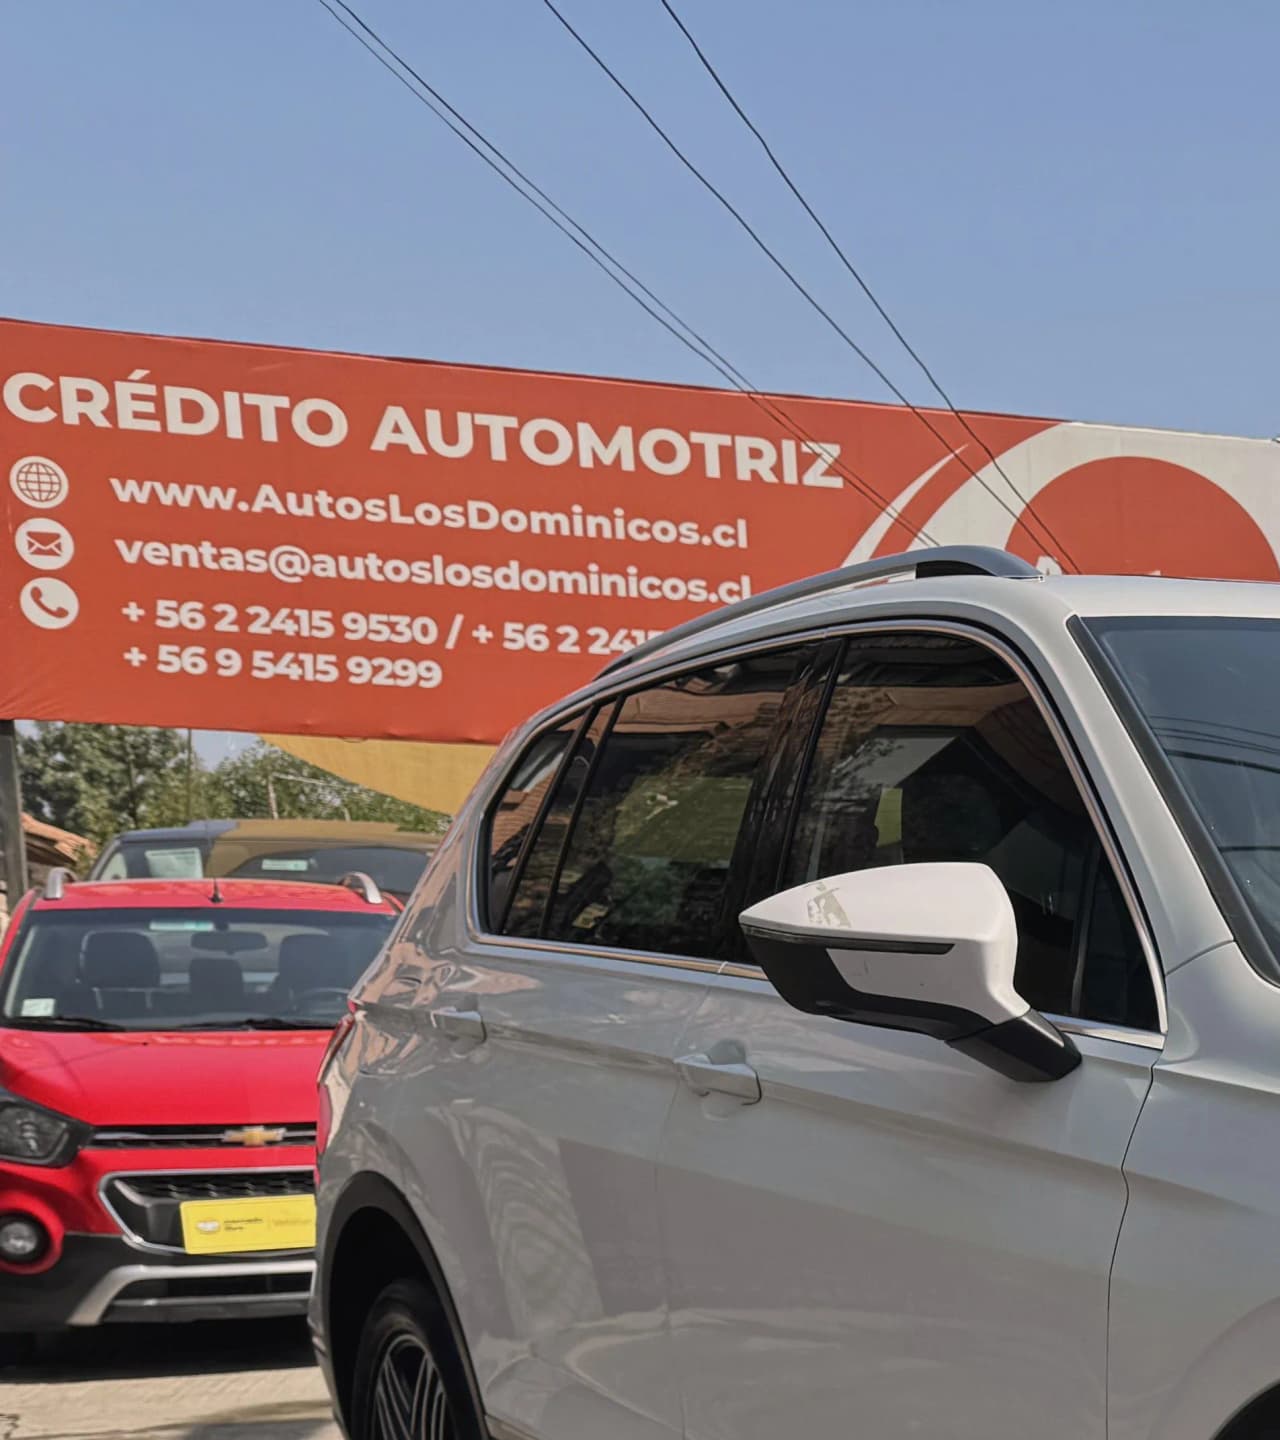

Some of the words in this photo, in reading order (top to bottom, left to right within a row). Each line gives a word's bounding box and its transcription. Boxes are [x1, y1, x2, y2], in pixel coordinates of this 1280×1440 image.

[3, 369, 348, 448] CRÉDITO
[370, 404, 845, 489] AUTOMOTRIZ
[110, 477, 748, 549] www.AutosLosDominicos.cl
[114, 538, 751, 605] ventas@autoslosdominicos.cl
[155, 599, 206, 630] 56
[213, 603, 239, 633] 2
[246, 605, 335, 639] 2415
[342, 611, 438, 645] 9530
[503, 622, 550, 652] 56
[556, 625, 581, 653] 2
[157, 644, 208, 675] 56
[215, 647, 242, 677] 9
[251, 650, 339, 683] 5415
[346, 656, 443, 689] 9299
